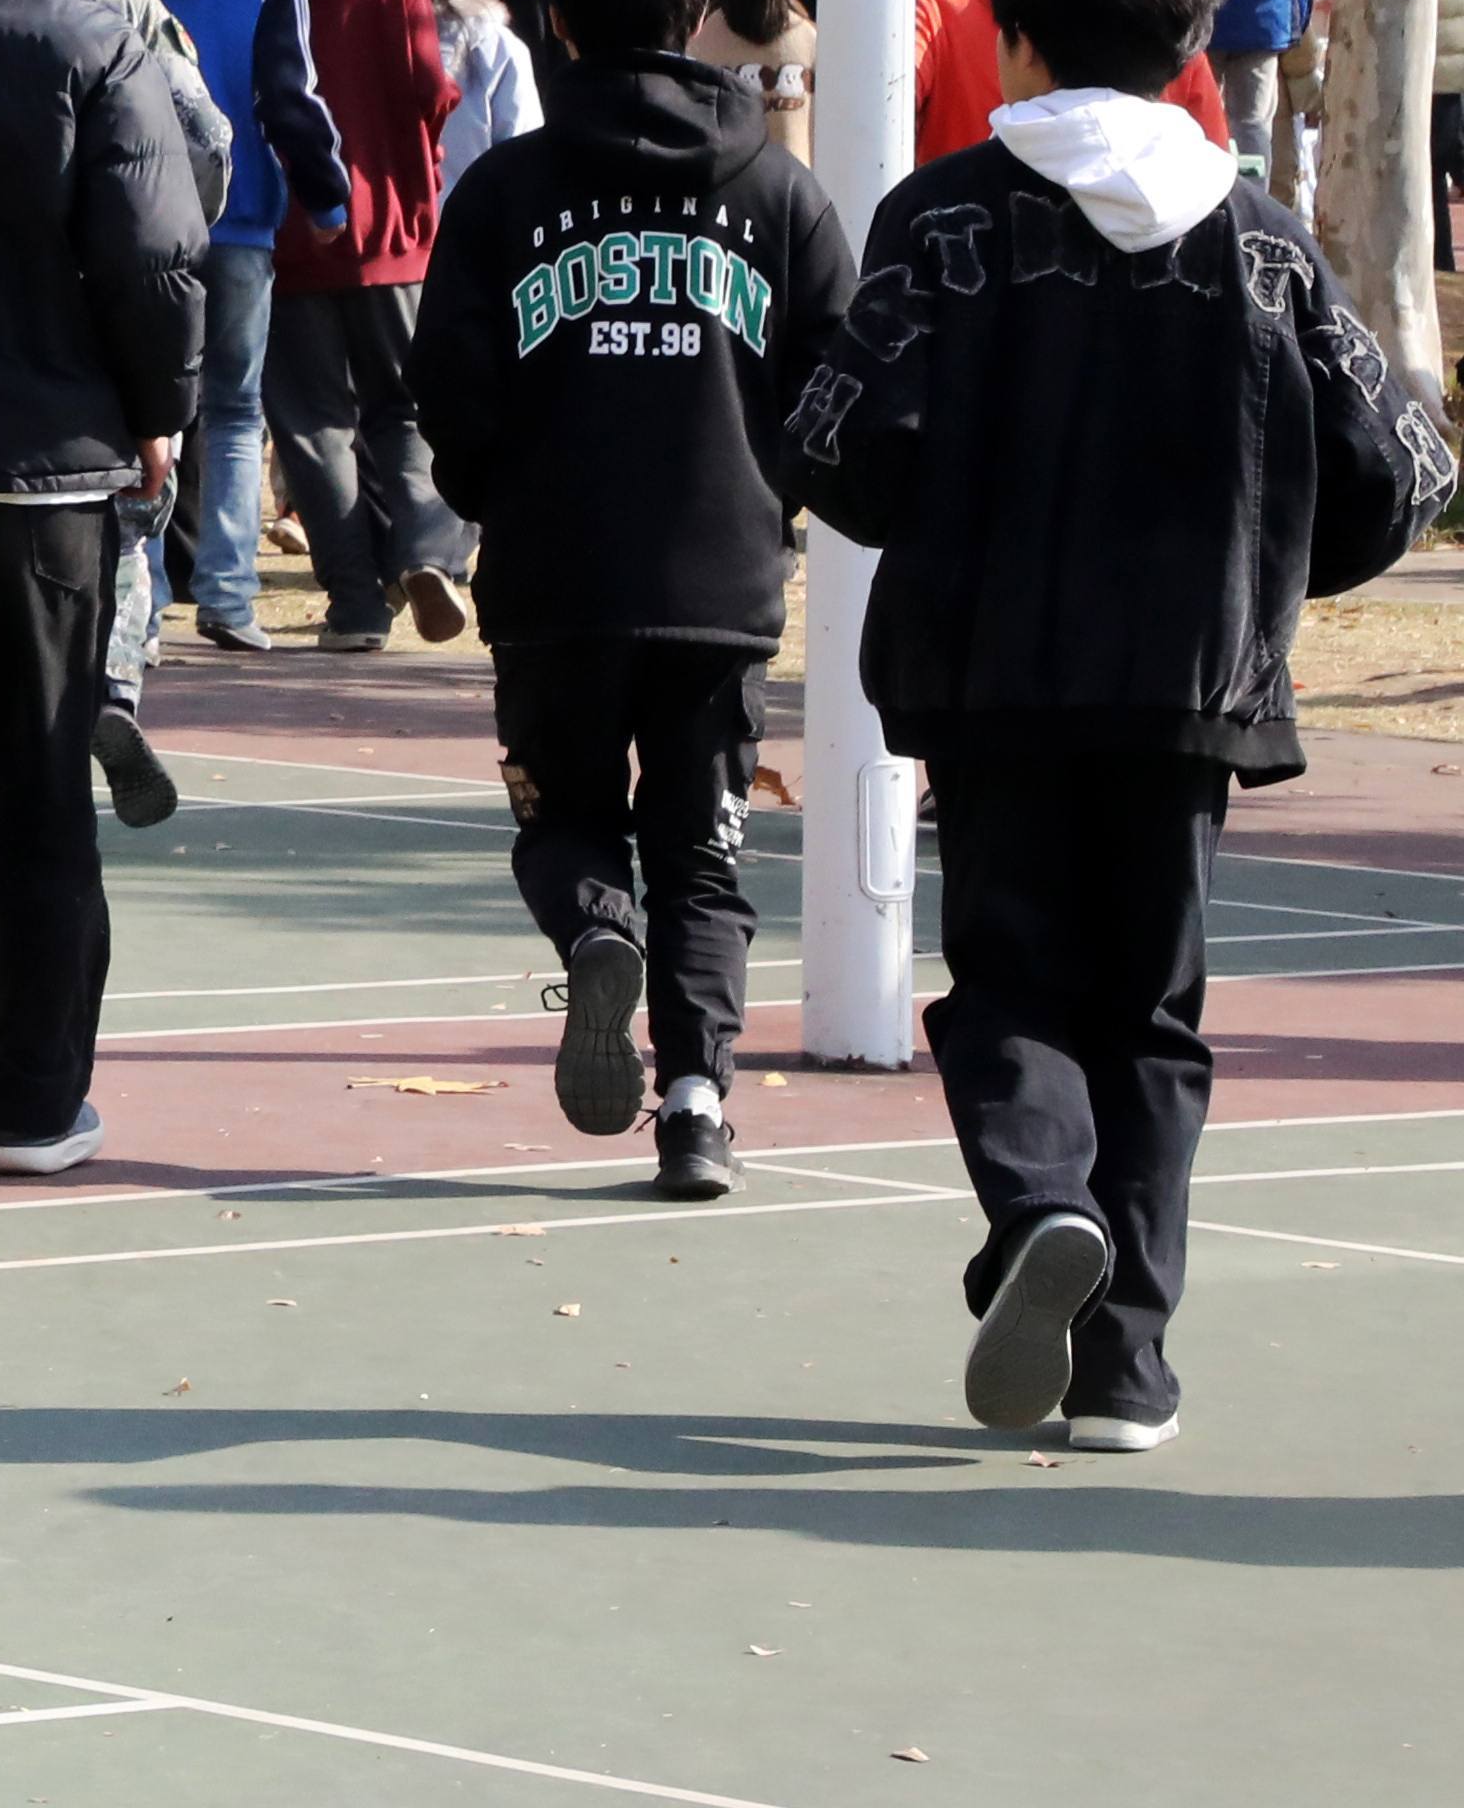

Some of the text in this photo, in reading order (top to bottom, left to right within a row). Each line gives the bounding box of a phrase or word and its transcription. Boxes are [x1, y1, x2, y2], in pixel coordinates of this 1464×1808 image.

[532, 195, 754, 247] ORIGINAL
[511, 230, 772, 360] BOSTON
[588, 320, 701, 356] EST.98
